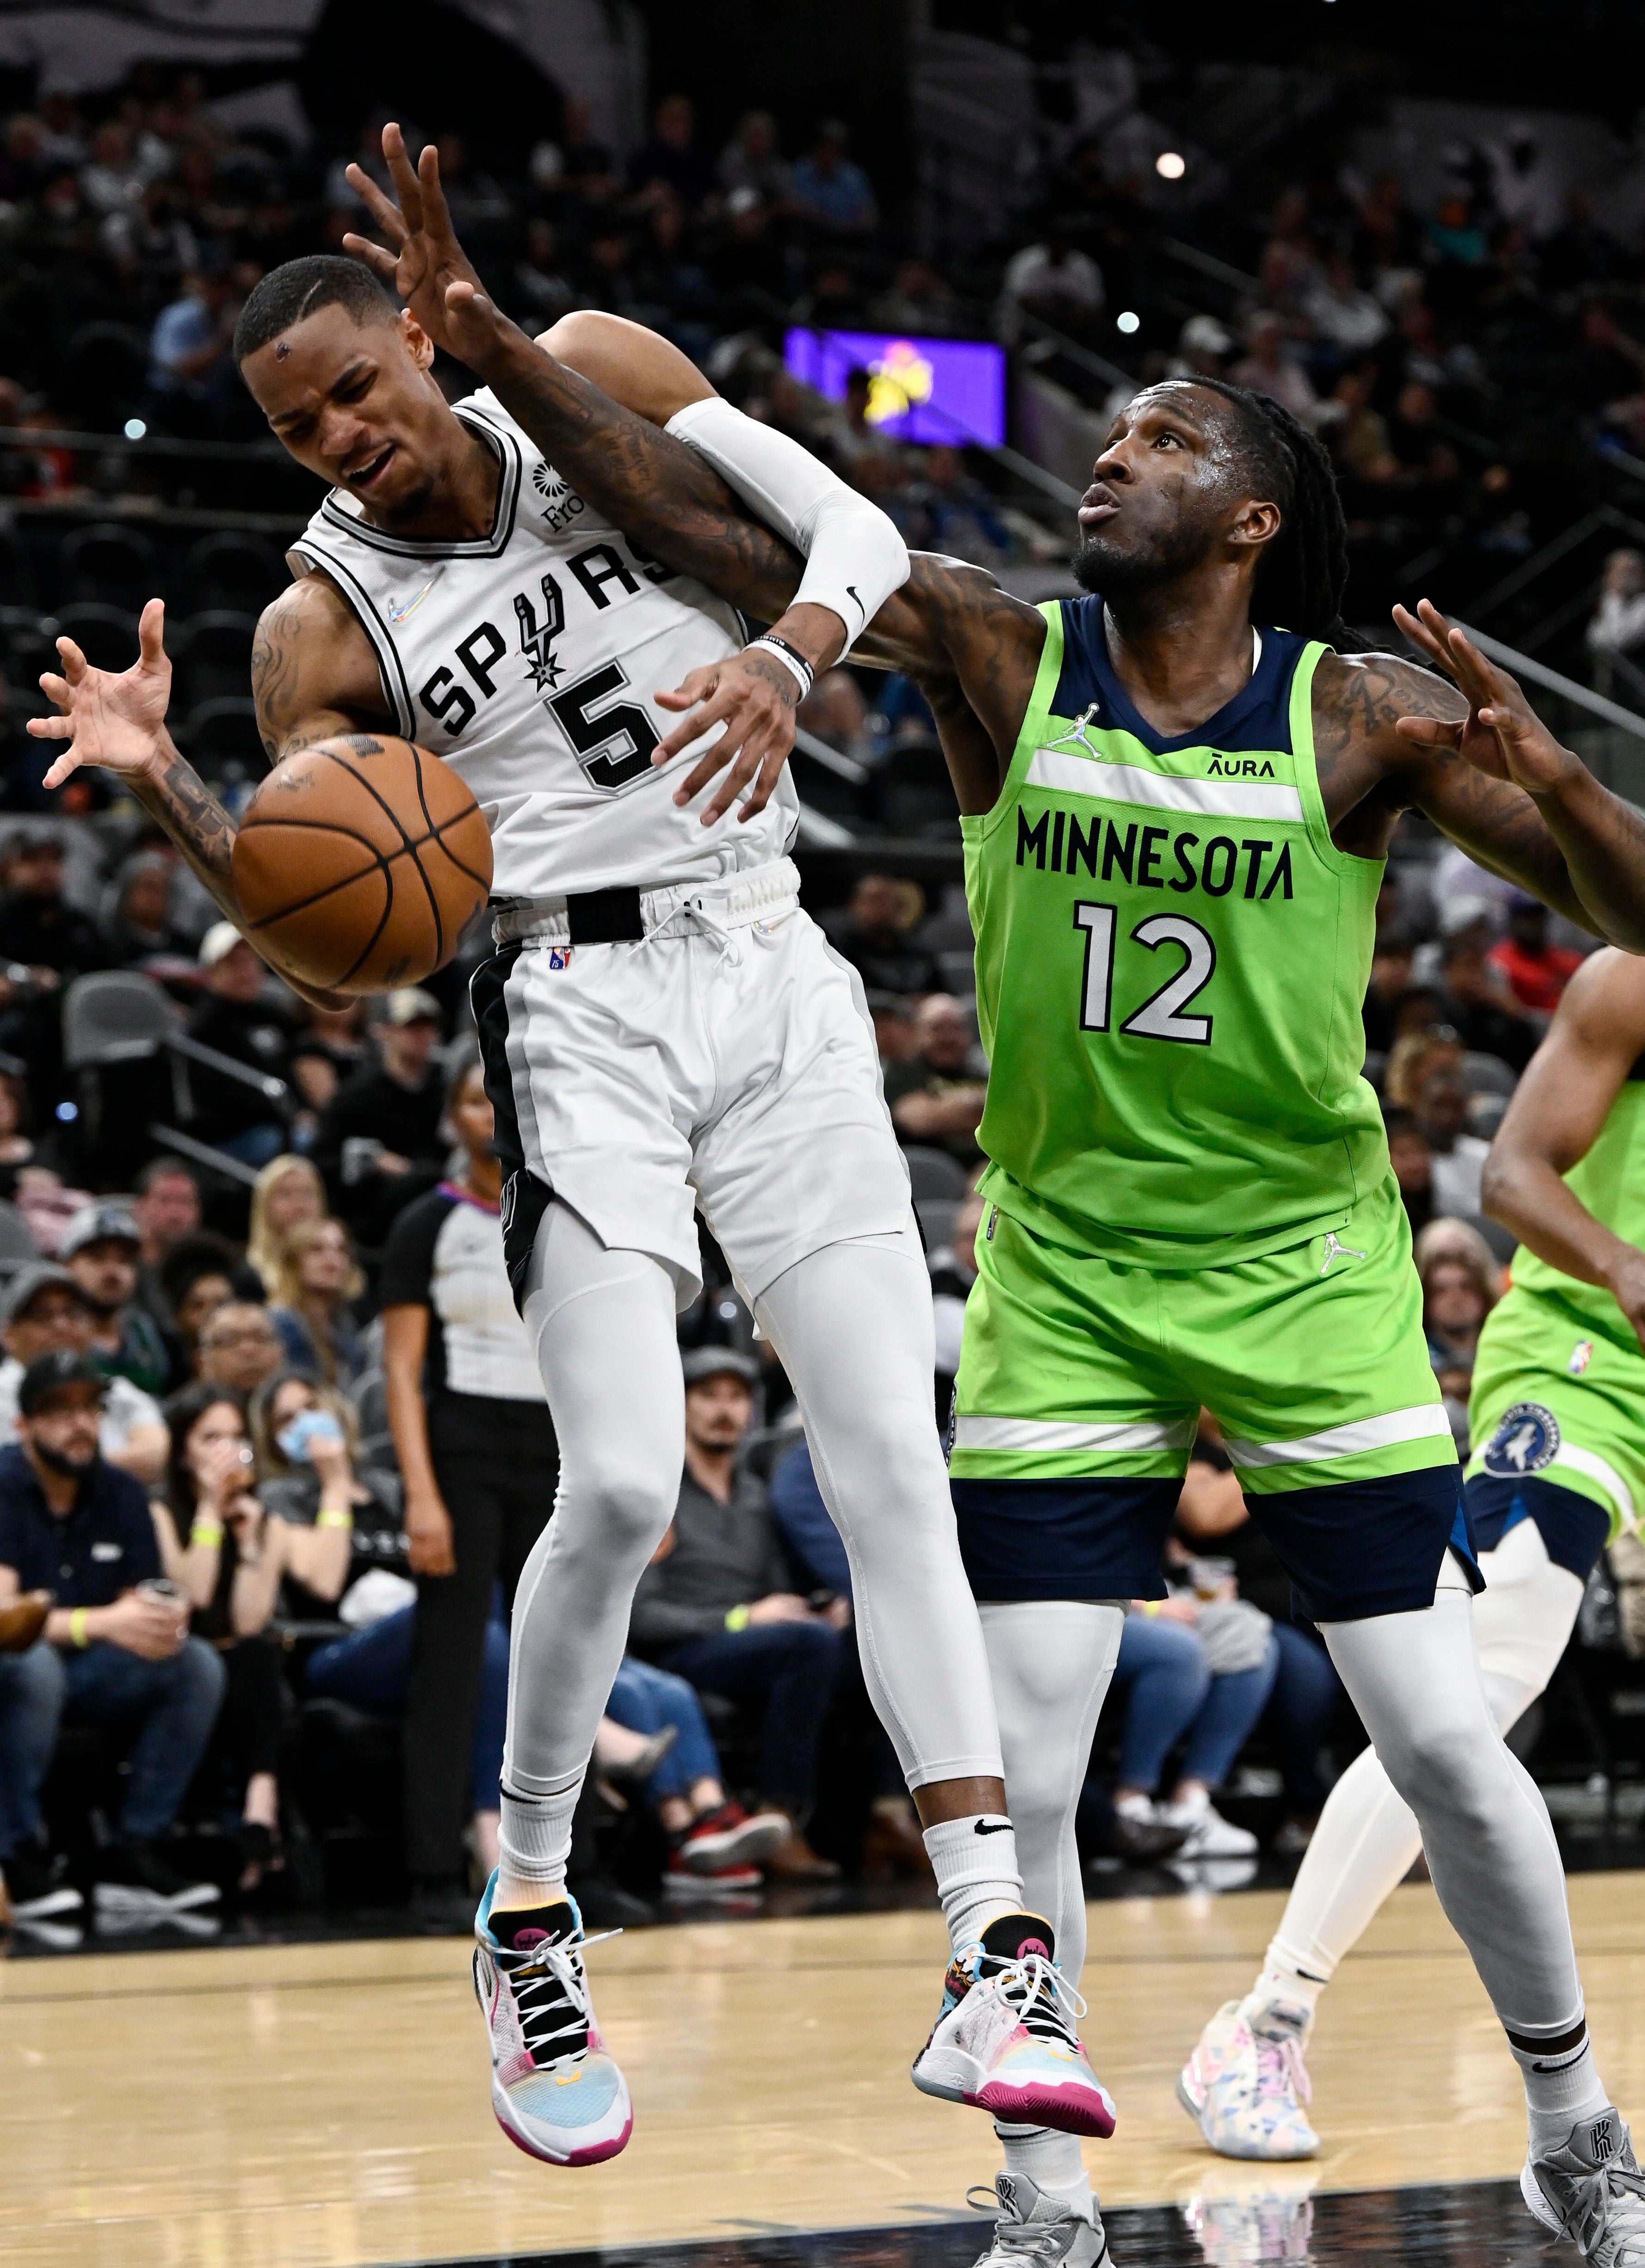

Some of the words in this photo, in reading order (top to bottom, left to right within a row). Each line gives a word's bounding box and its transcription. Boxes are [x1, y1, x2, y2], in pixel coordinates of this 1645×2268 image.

[543, 657, 663, 793] 5
[1016, 804, 1293, 900] MINNESOTA
[1072, 899, 1217, 1046] 12
